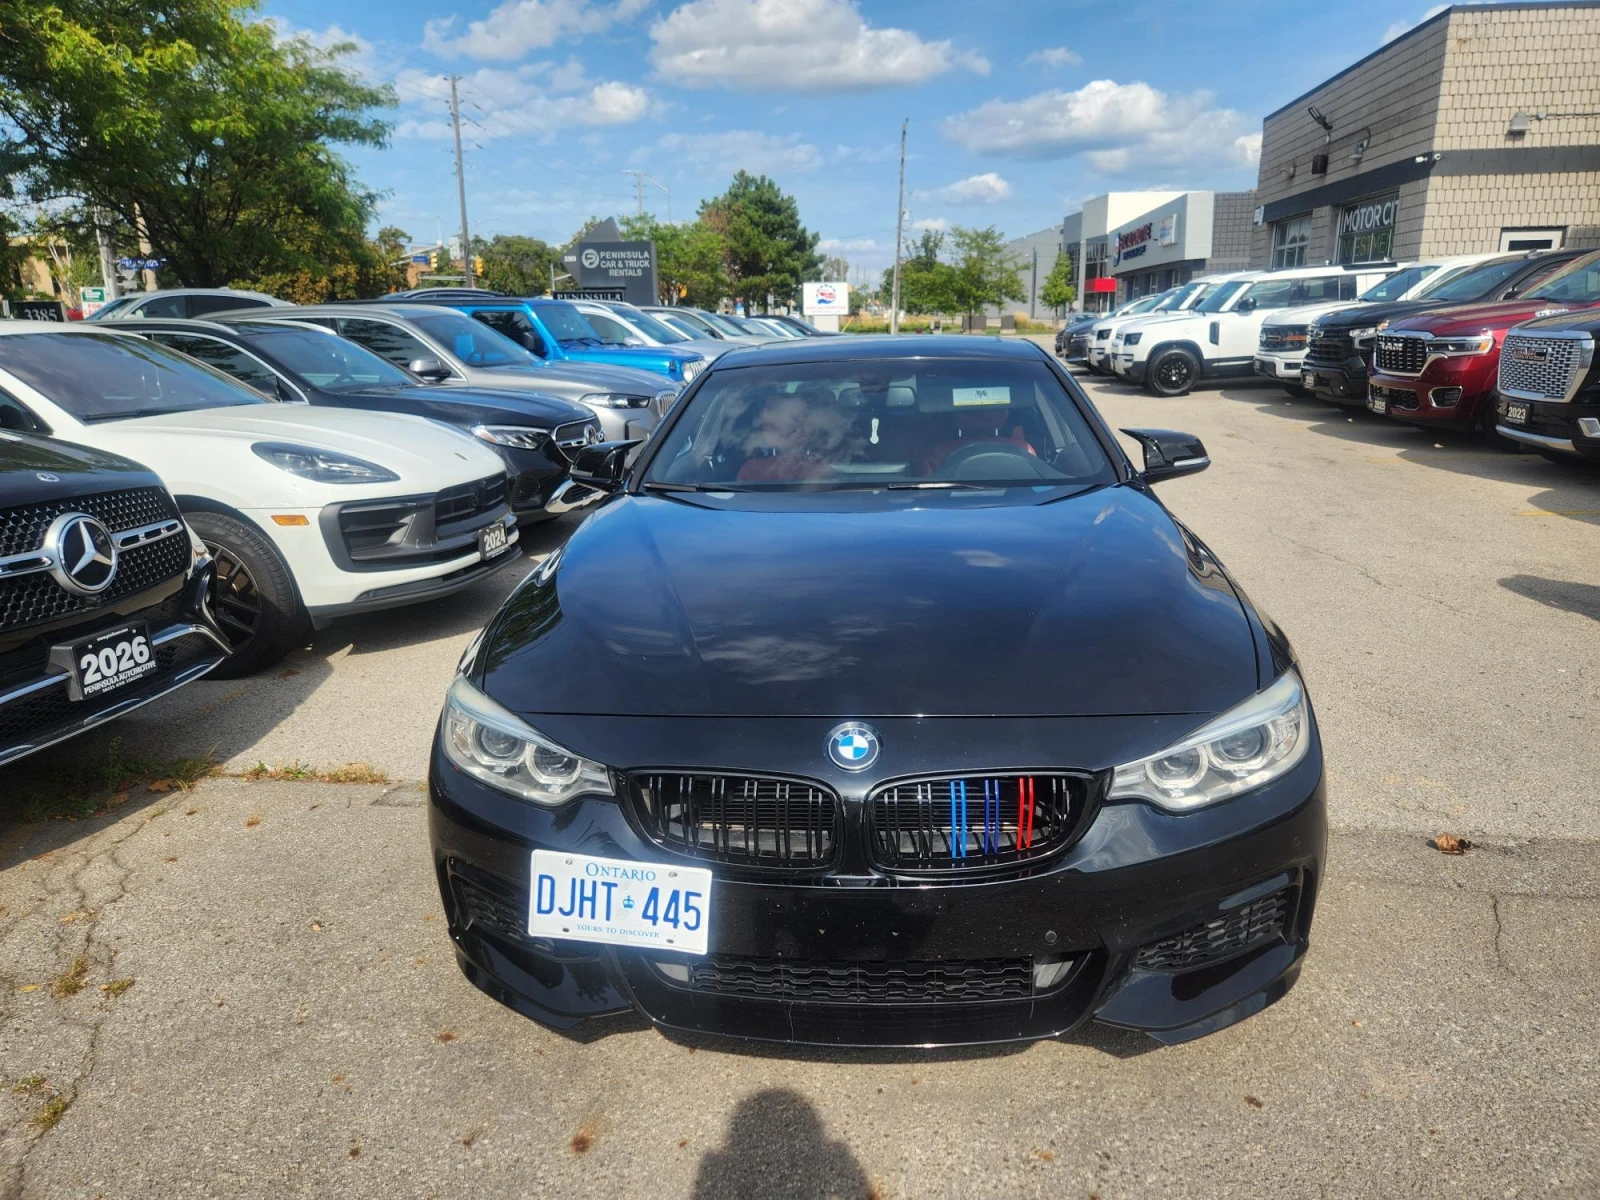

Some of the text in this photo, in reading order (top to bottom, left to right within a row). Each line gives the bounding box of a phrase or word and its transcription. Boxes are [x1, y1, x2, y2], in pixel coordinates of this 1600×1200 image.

[1342, 204, 1382, 233] MOTOR
[600, 251, 650, 259] PENINSULA
[600, 260, 650, 268] CAR & TRUCK
[609, 269, 643, 277] RENTALS
[557, 293, 622, 301] PENINSULA
[24, 308, 57, 321] 3385
[1507, 406, 1526, 419] 2023
[484, 527, 506, 552] 2024
[80, 635, 150, 686] 2026
[84, 660, 156, 694] PENINSULA AUTOMOTIVE
[834, 729, 874, 741] BMW
[585, 862, 657, 882] ONTARIO
[536, 874, 702, 931] DJHT 445
[577, 923, 660, 938] YOURS TO DISCOVER
